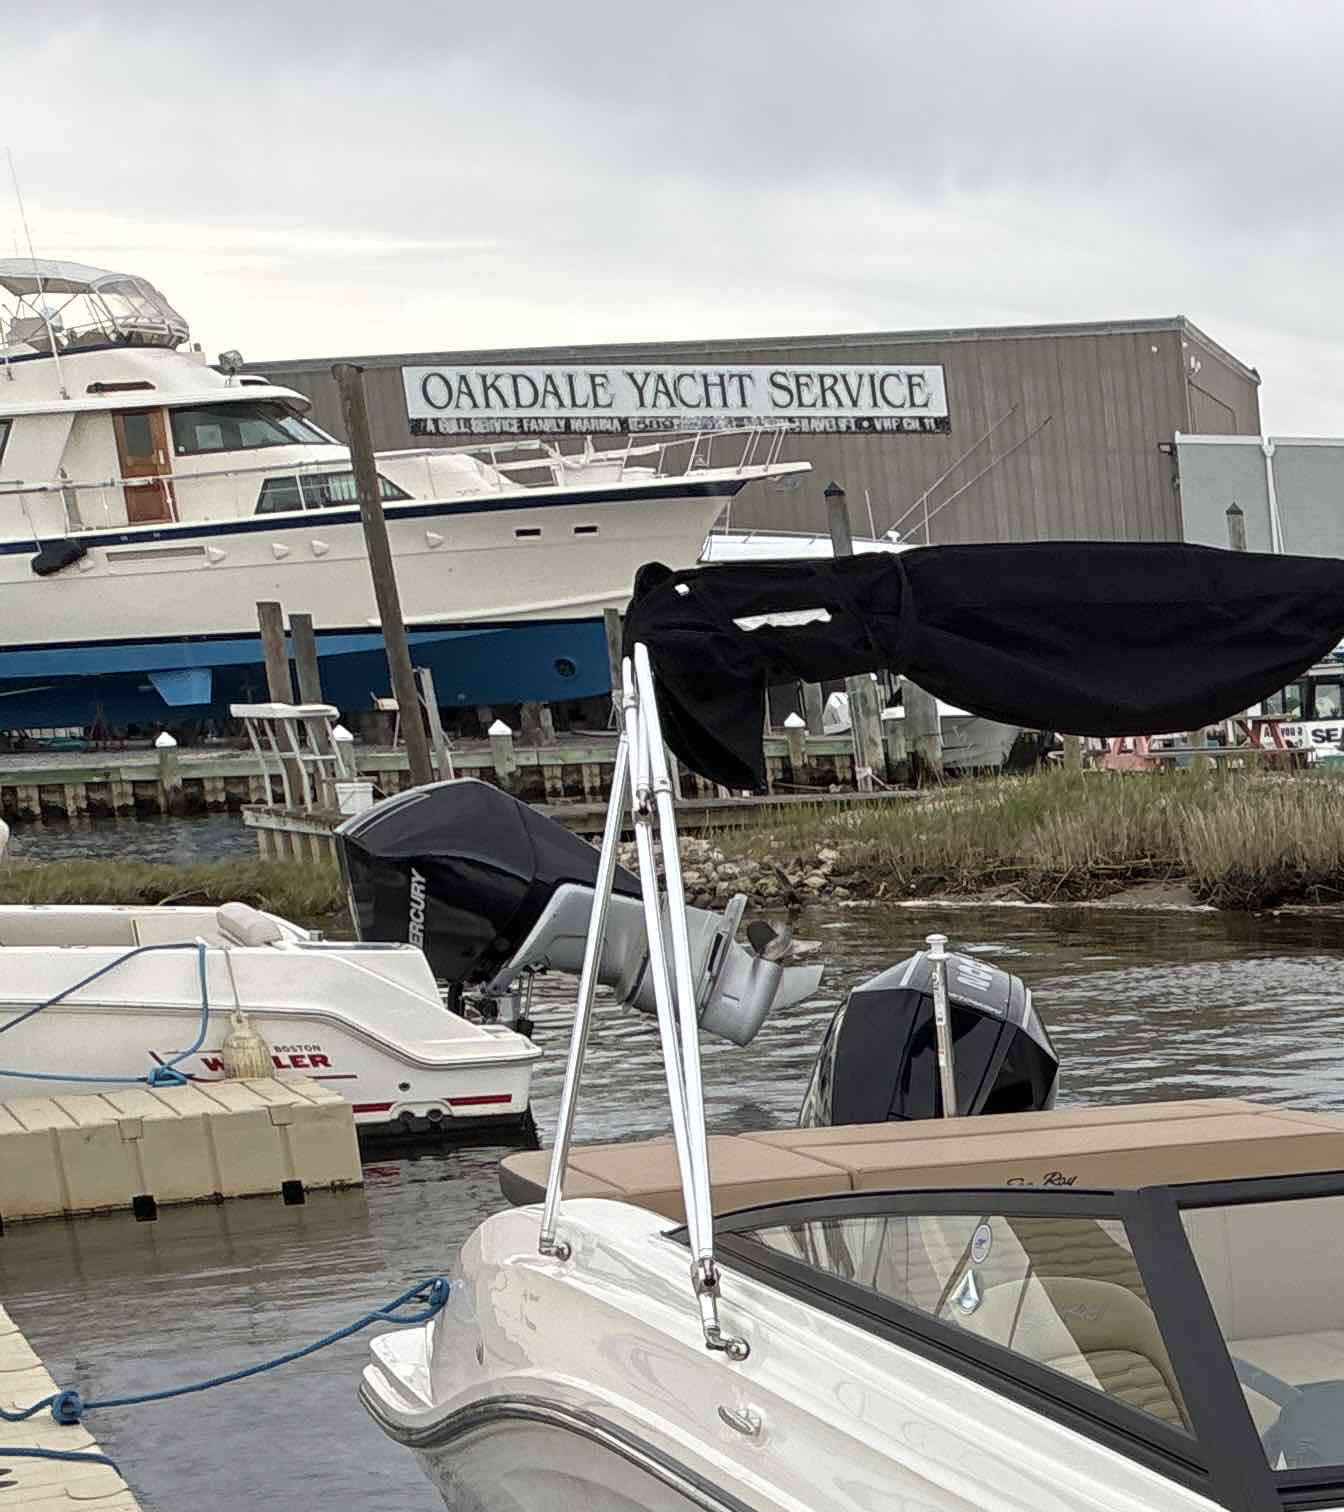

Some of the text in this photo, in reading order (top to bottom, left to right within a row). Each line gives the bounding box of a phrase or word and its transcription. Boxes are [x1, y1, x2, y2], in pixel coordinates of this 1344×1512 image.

[421, 371, 933, 410] OAKDALE YACHT SERVICE
[408, 866, 427, 949] ERCURY
[200, 1053, 332, 1073] WLER
[273, 1044, 321, 1053] BOSTON
